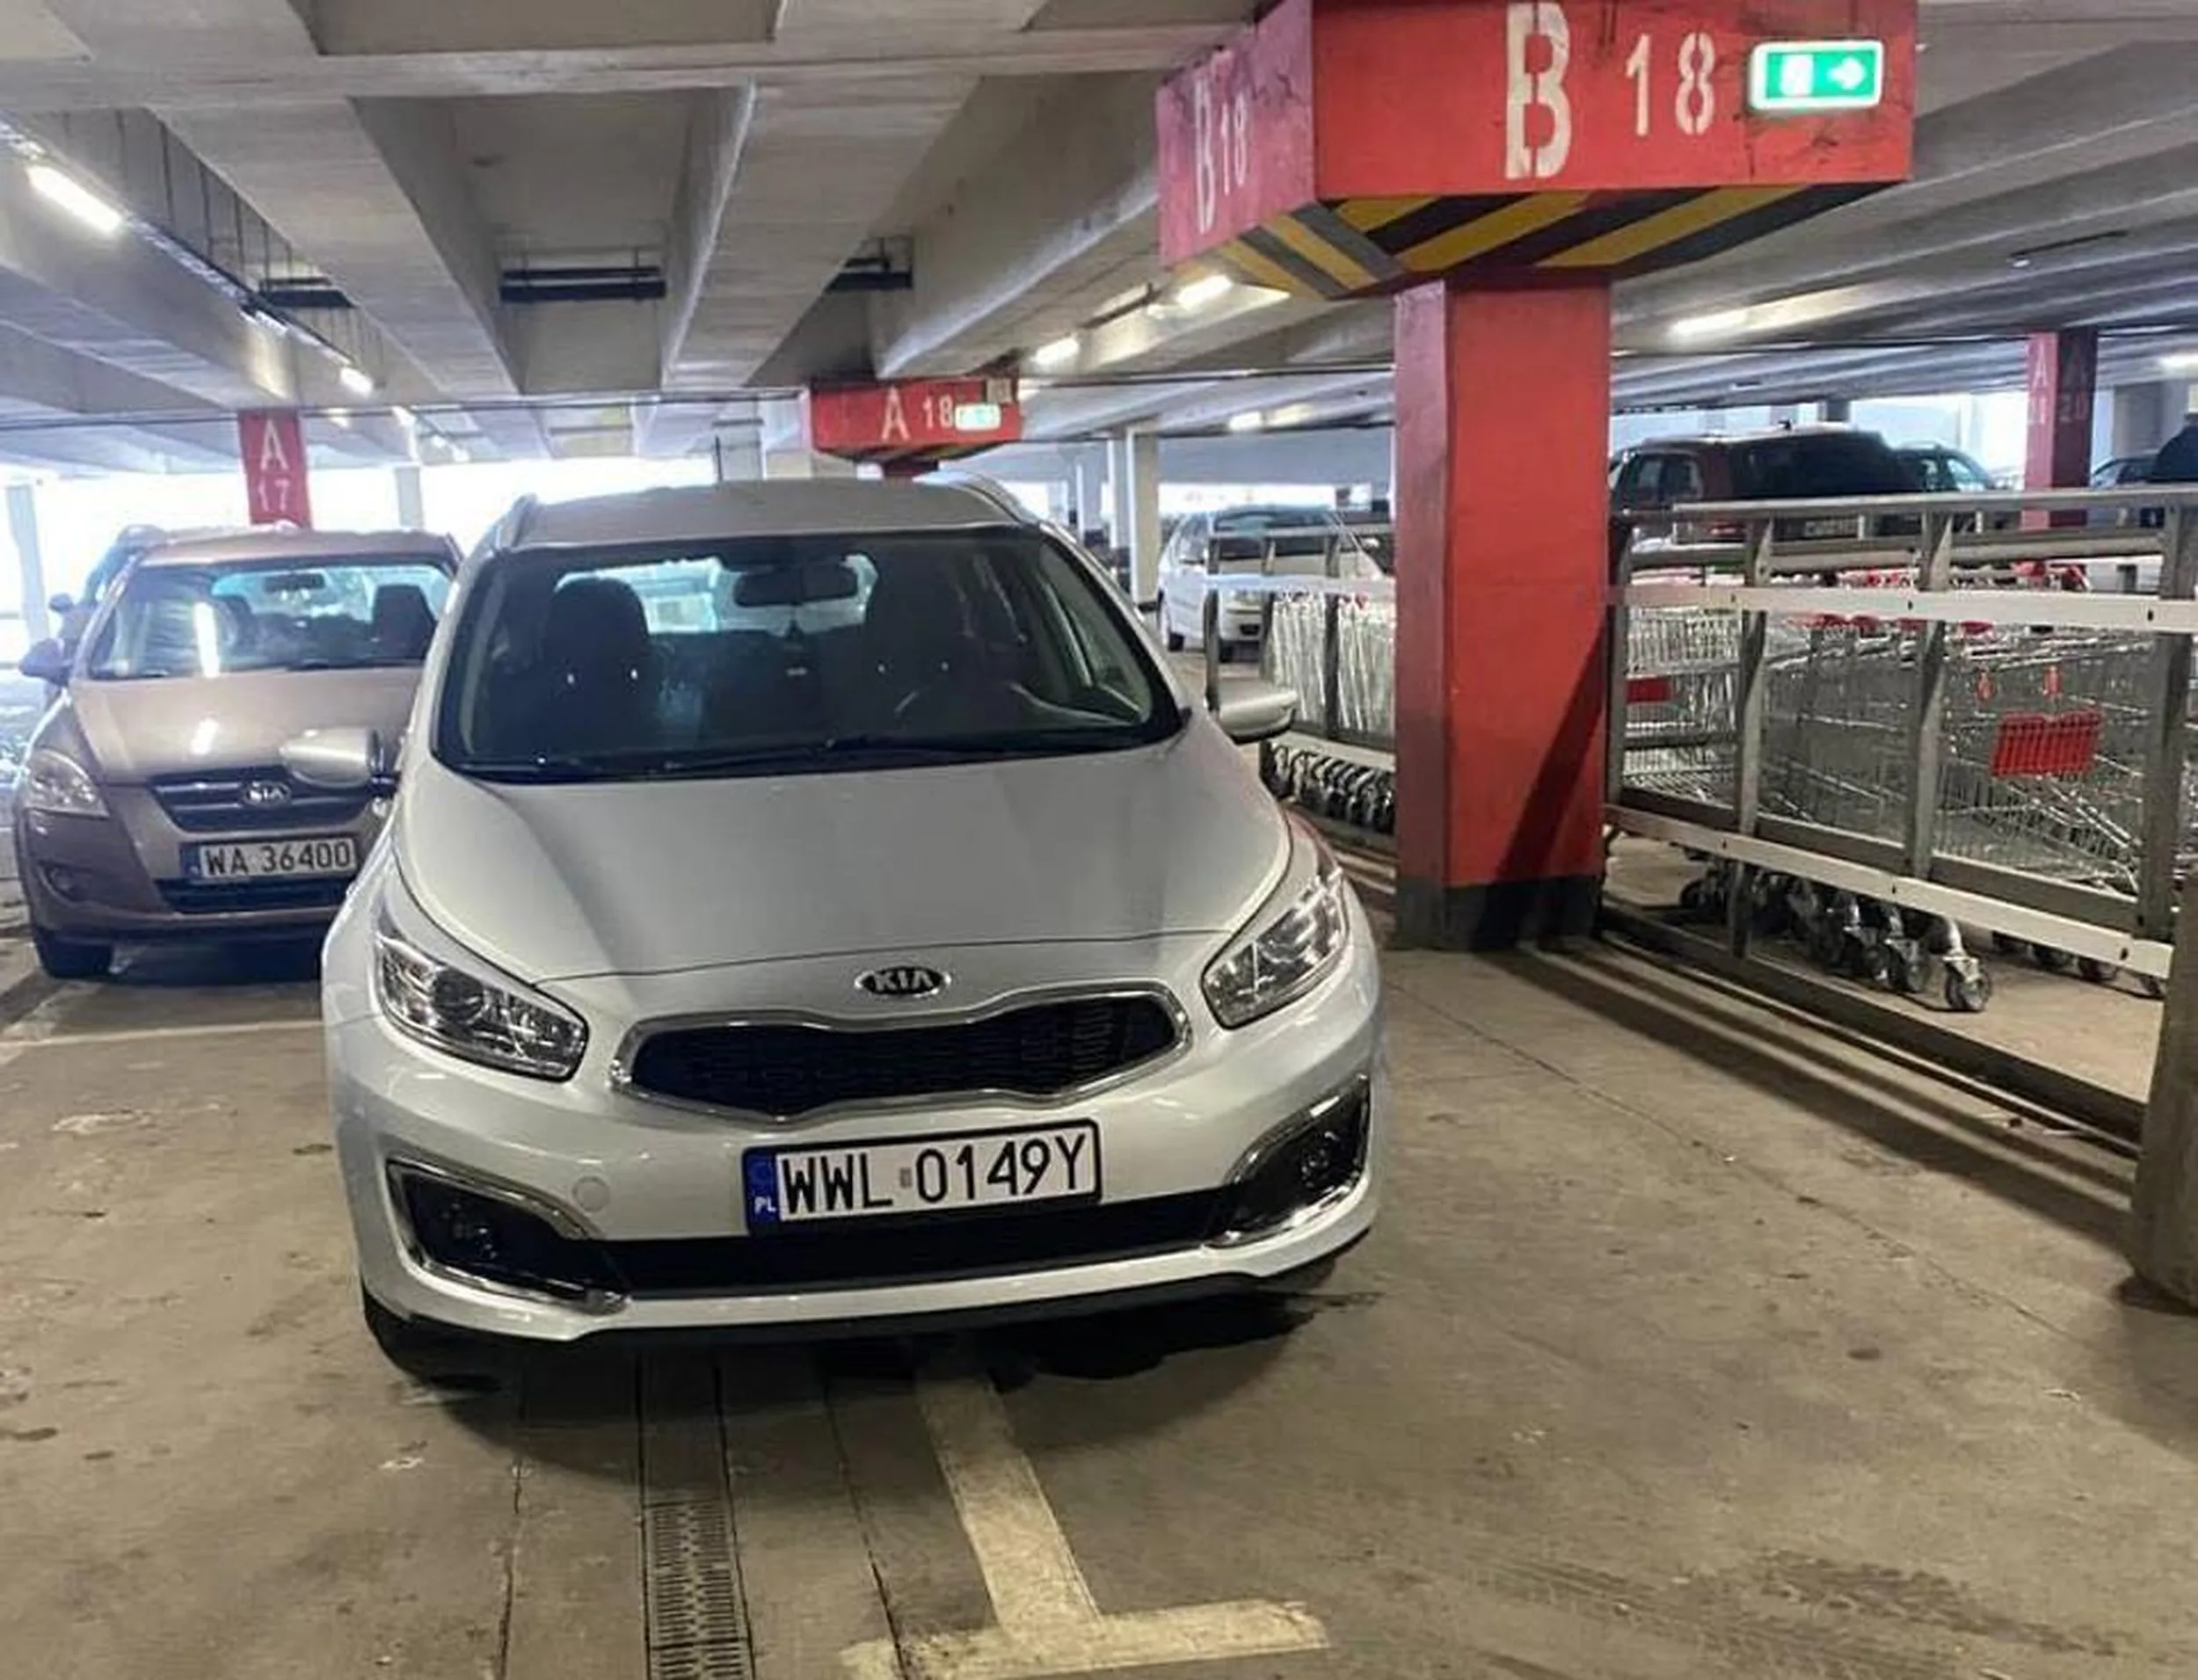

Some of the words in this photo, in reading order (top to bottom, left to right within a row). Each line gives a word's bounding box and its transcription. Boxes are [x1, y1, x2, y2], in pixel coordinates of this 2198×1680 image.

[1505, 2, 1572, 179] B
[1626, 32, 1715, 136] 18
[1196, 79, 1215, 235] B
[1220, 92, 1248, 196] 18
[881, 385, 910, 441] A
[922, 395, 954, 429] 18
[260, 419, 289, 471] A
[258, 477, 290, 512] 17
[207, 847, 249, 876] WA
[259, 841, 350, 873] 36400
[875, 970, 934, 991] KIA
[782, 1152, 893, 1215] WWL
[915, 1132, 1087, 1203] 0149Y
[754, 1196, 777, 1214] PL
